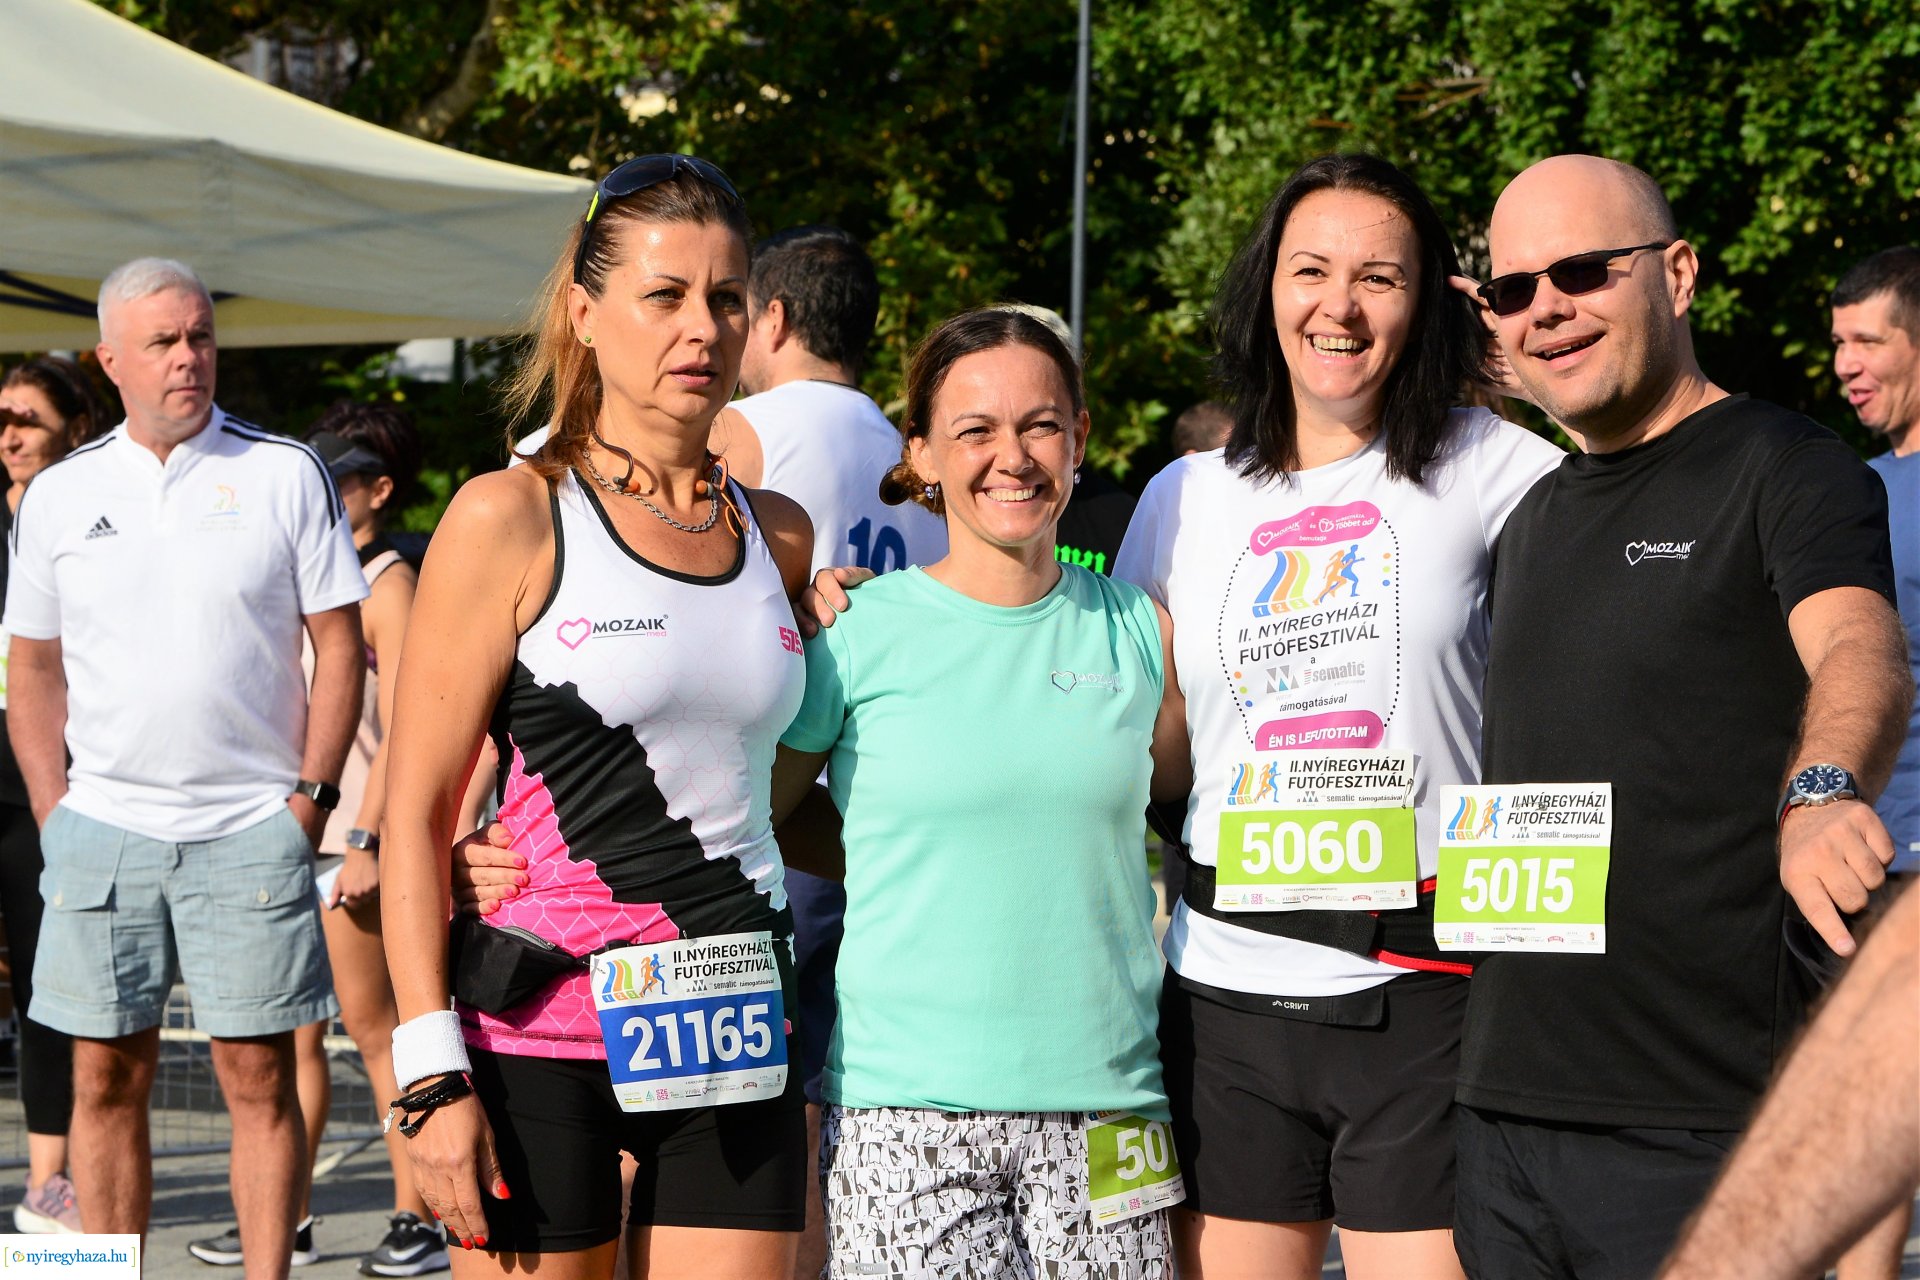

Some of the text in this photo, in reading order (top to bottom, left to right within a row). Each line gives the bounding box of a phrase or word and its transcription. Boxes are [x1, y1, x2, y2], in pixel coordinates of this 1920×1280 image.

[1335, 519, 1361, 531] Többet
[1646, 541, 1692, 554] MOZAIK
[1238, 602, 1379, 644] II. NYÍREGYHÁZI
[1239, 622, 1380, 665] FUTÓFESZTIVÁL
[1310, 656, 1316, 664] a
[1312, 661, 1366, 682] sematic
[1279, 693, 1348, 712] támogatásával
[1268, 725, 1369, 748] ÉN IS LEFUTOTTAM
[1289, 756, 1406, 773] II.NYÍREGYHÁZI
[1288, 773, 1406, 789] FUTÓFESZTIVÁL
[1326, 794, 1355, 802] sematic
[1358, 795, 1403, 803] támogatásával
[1536, 831, 1561, 839] sematic
[1562, 832, 1601, 840] támogatásával
[1241, 819, 1383, 875] 5060
[1460, 857, 1575, 913] 5015
[674, 955, 775, 981] FUTÓFESZTIVÁL
[713, 980, 737, 989] sematic
[1283, 1001, 1310, 1011] CRIVIT
[621, 1003, 772, 1072] 21165
[1115, 1119, 1179, 1181] 50
